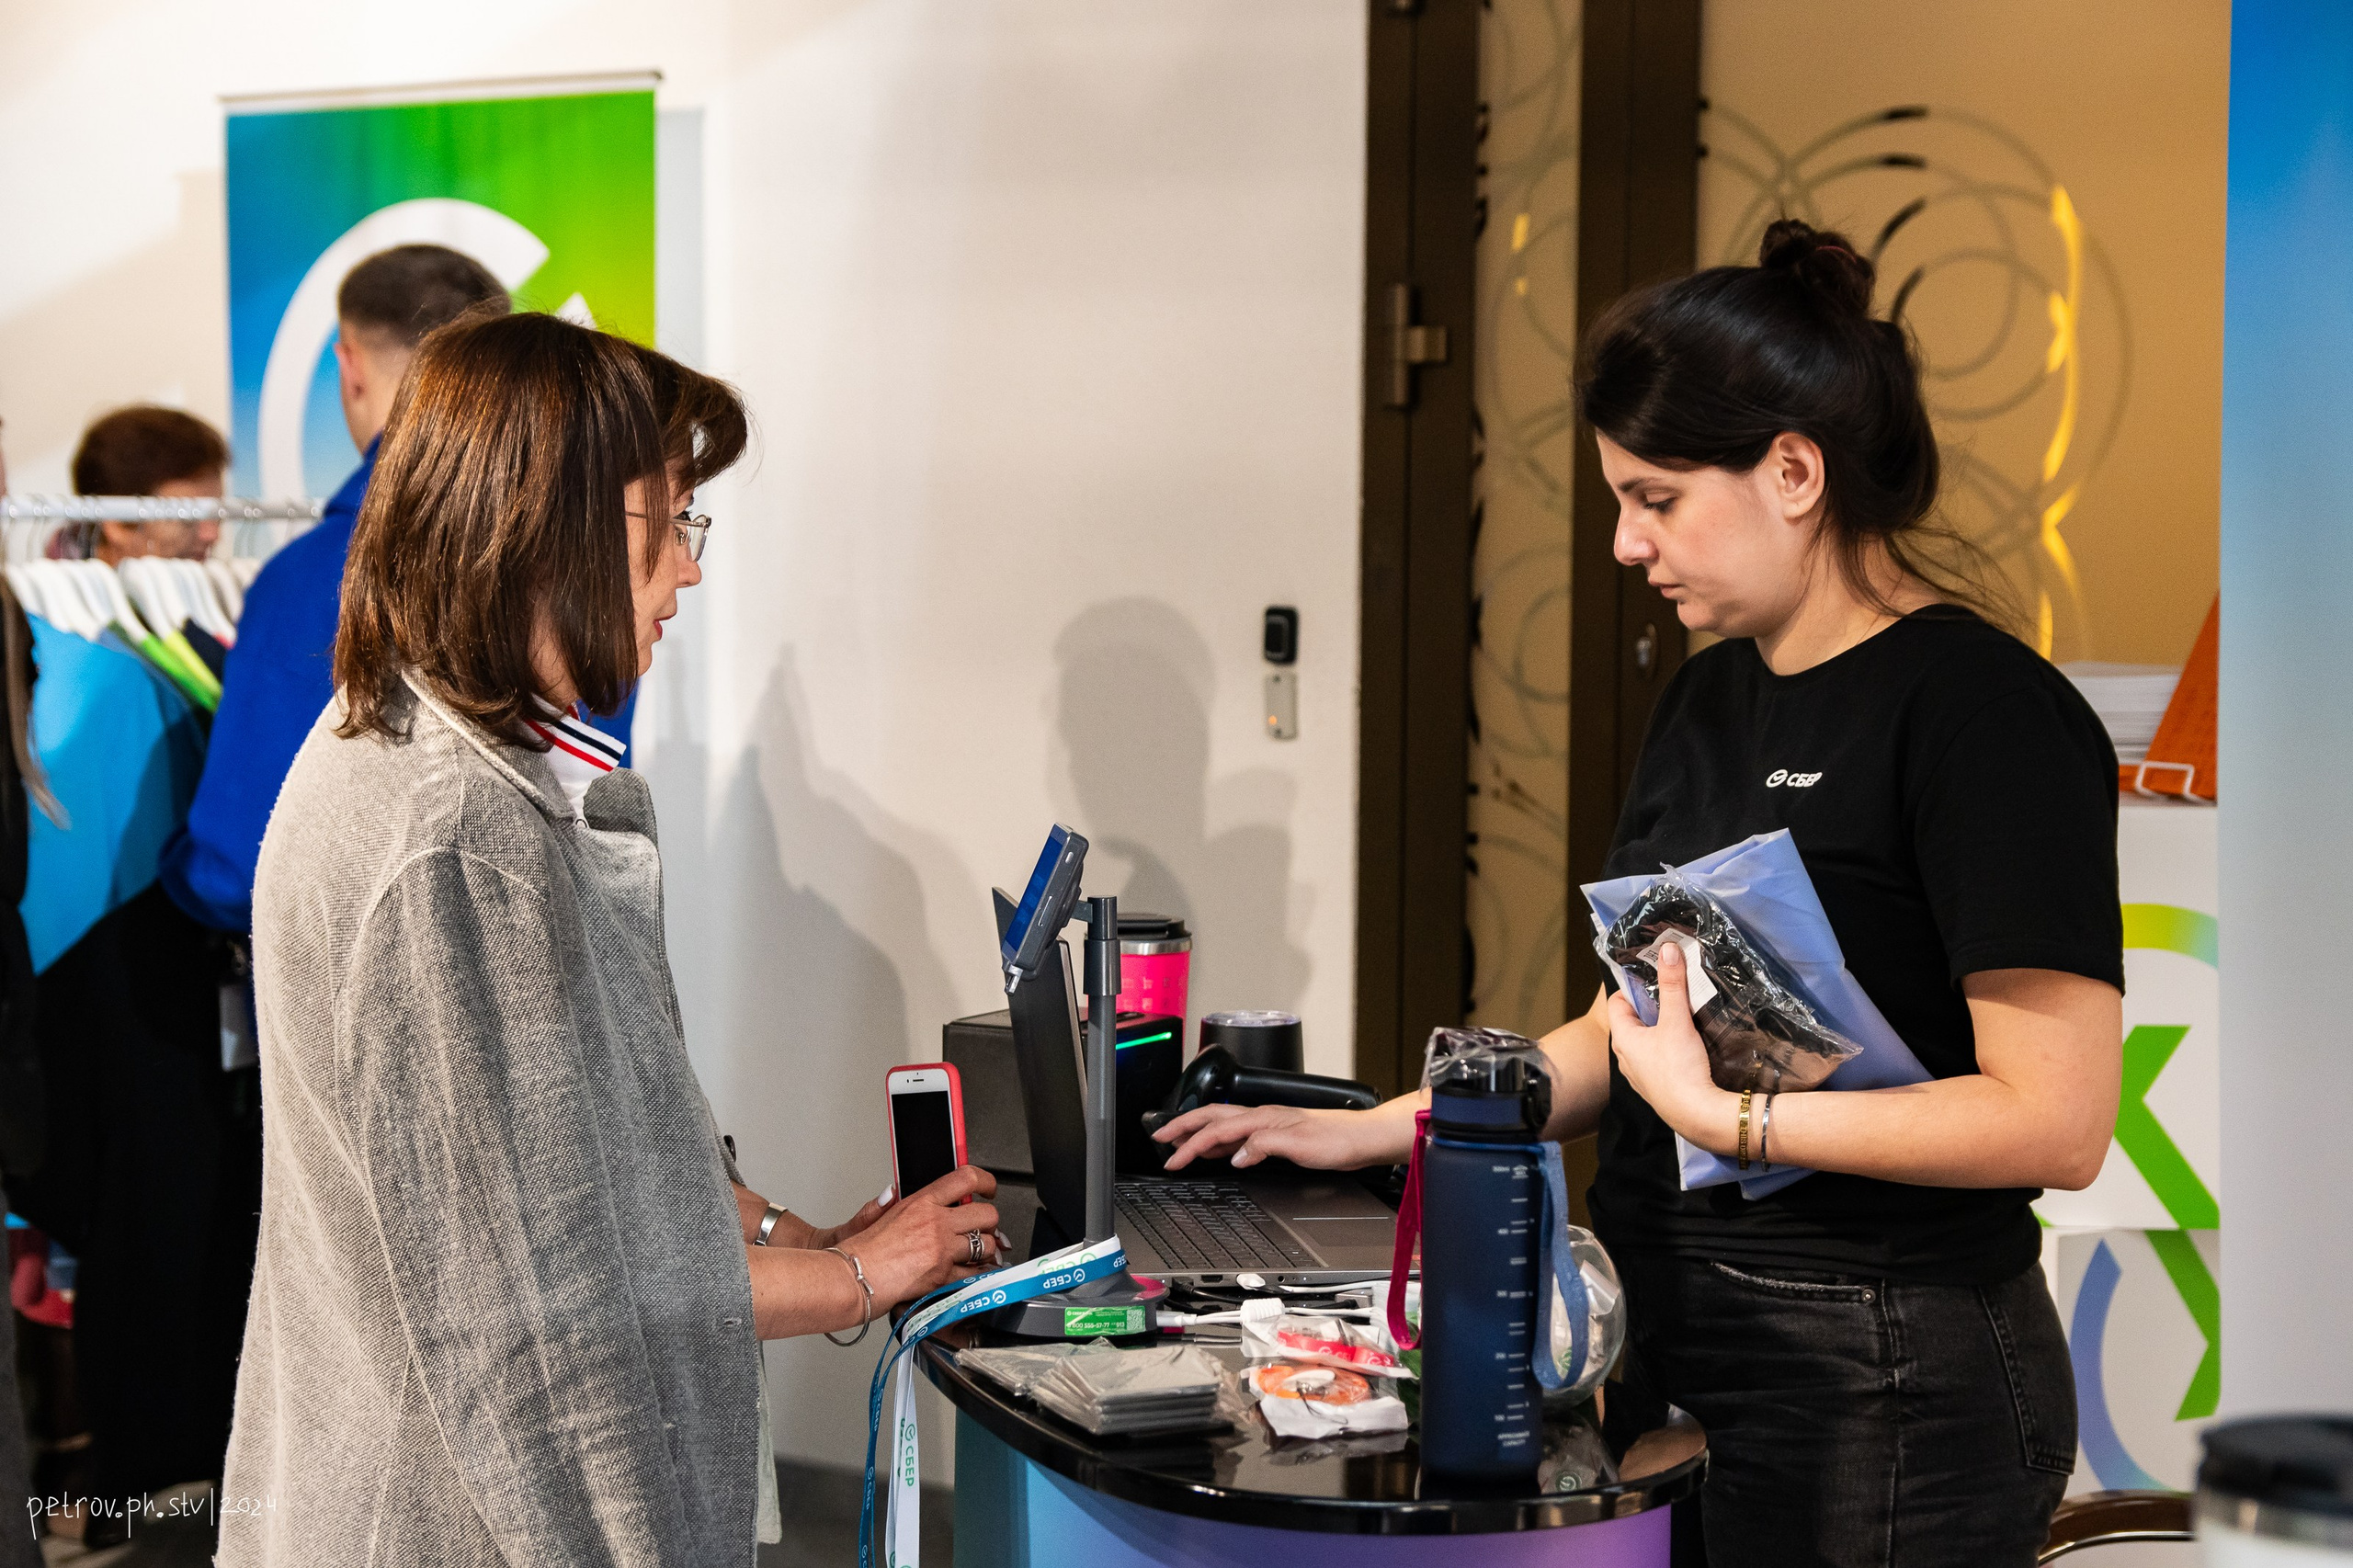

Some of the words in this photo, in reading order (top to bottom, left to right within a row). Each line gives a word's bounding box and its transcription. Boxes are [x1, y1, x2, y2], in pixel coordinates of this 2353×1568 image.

[1786, 772, 1823, 788] СБЕР
[1042, 1276, 1072, 1290] СБЕР
[960, 1296, 991, 1313] СБЕР
[905, 1445, 915, 1487] СБЕР
